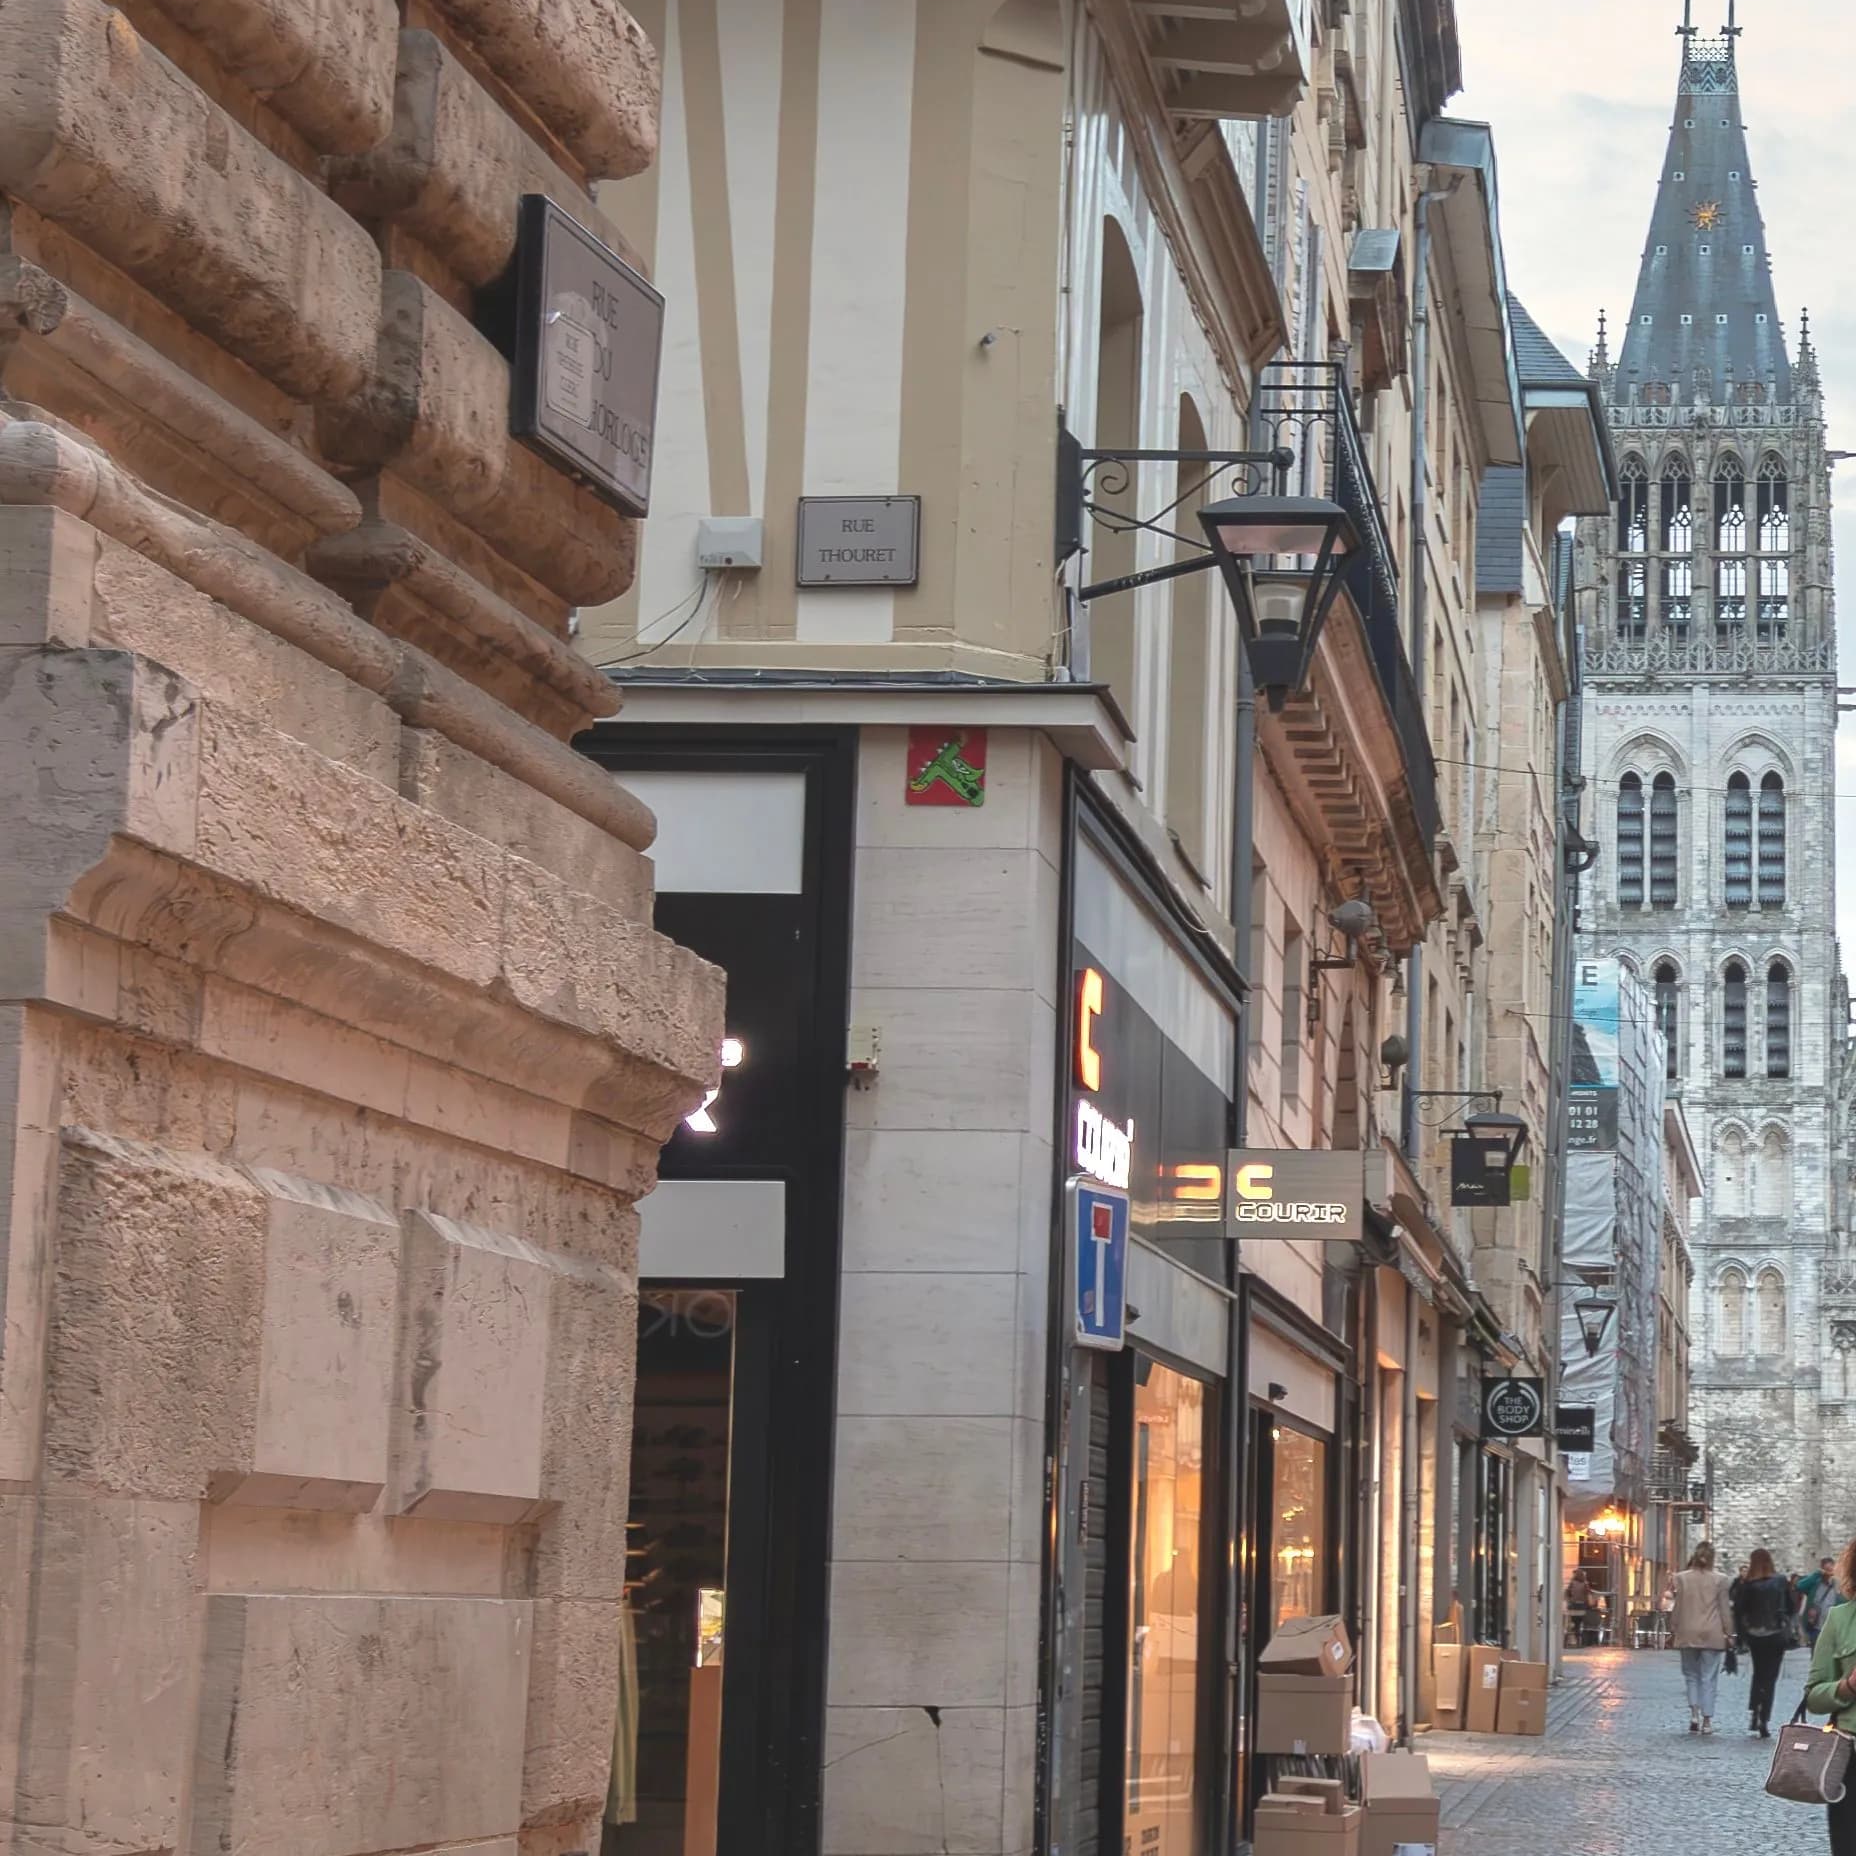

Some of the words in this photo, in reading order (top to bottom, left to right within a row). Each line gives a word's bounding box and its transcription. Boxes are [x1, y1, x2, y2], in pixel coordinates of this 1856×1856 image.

[592, 280, 618, 331] RUE
[841, 519, 876, 533] RUE
[818, 548, 897, 563] THOURET
[1236, 1202, 1346, 1223] COURIR
[1503, 1397, 1522, 1405] THE
[1496, 1406, 1530, 1415] BODY
[1499, 1415, 1529, 1424] SHOP
